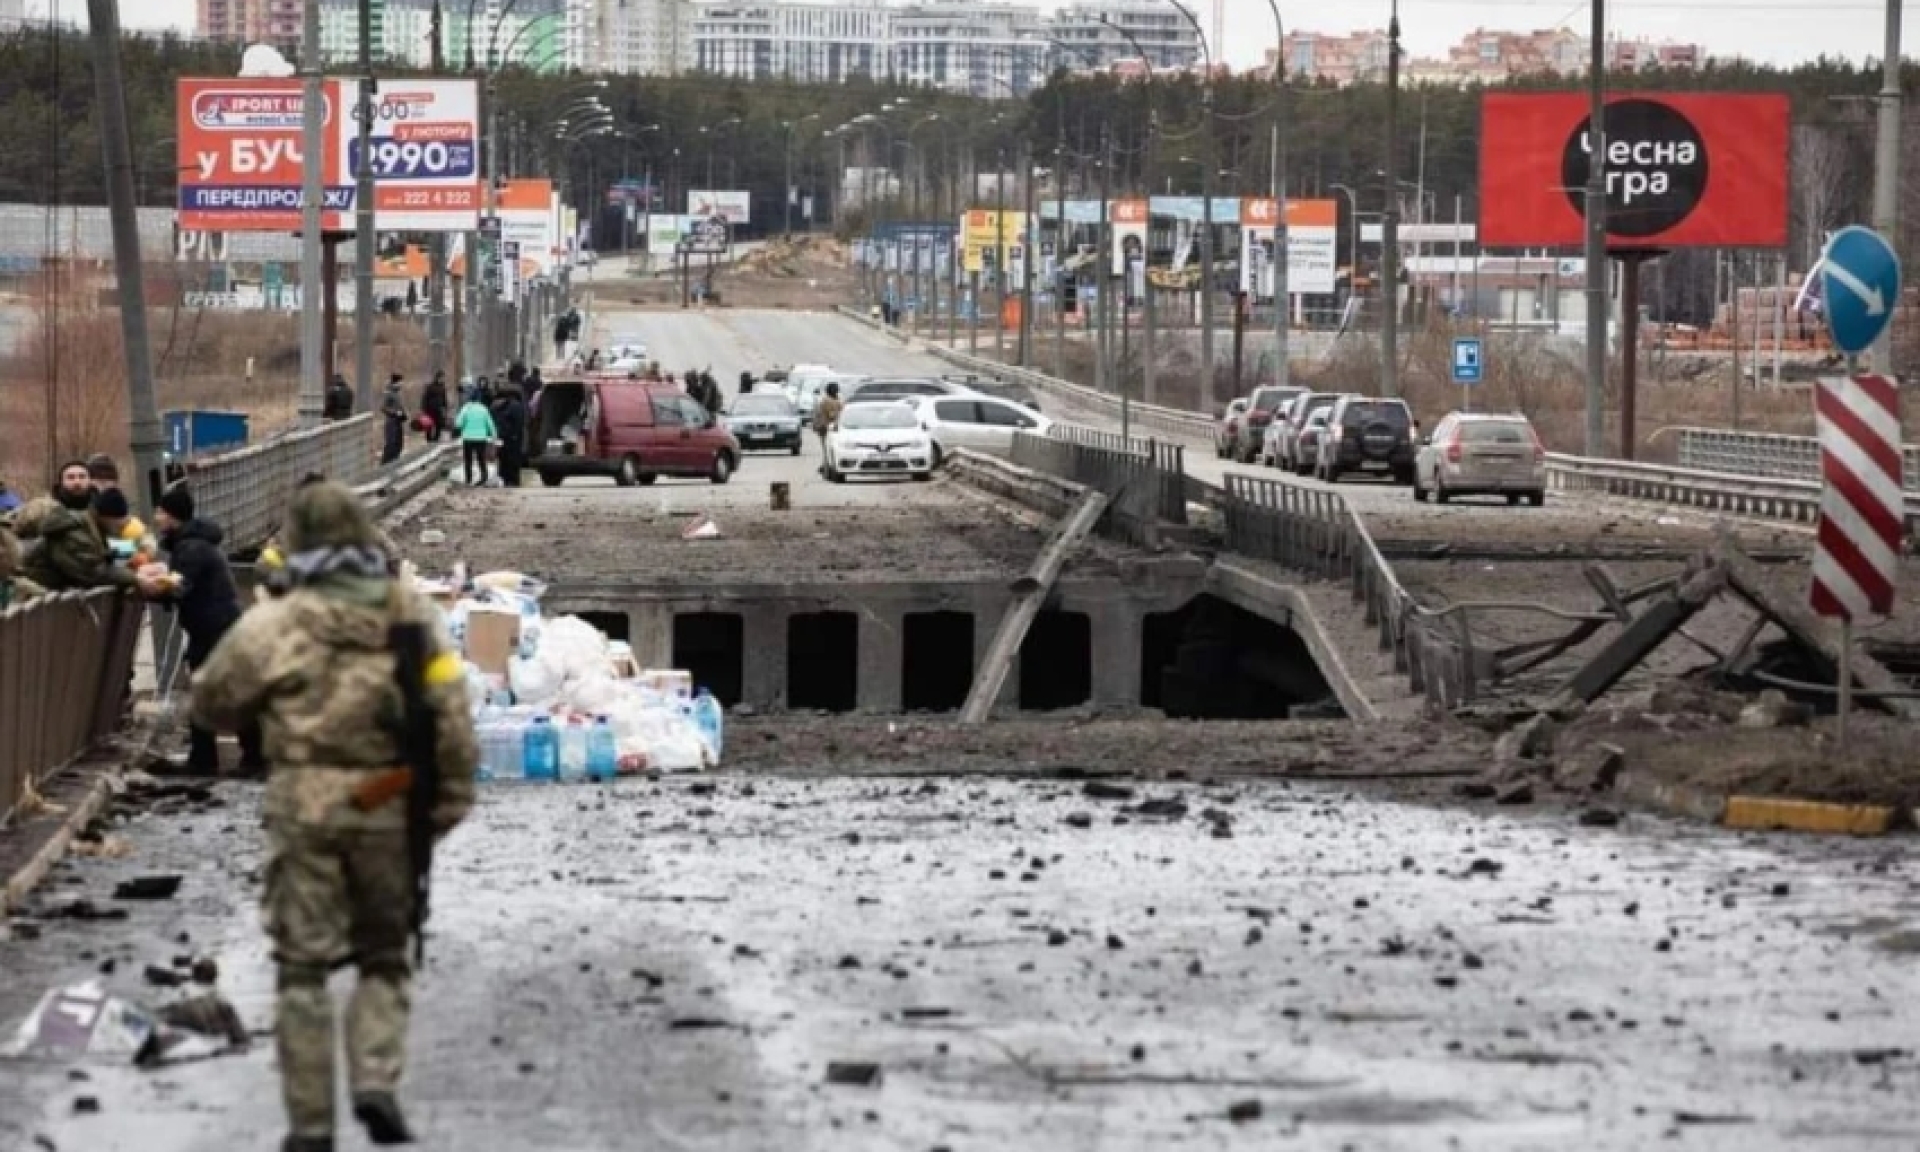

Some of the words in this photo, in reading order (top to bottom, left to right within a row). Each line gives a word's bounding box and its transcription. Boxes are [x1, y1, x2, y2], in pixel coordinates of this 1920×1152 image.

[196, 150, 220, 181] у
[231, 138, 304, 173] БУЧ
[1605, 171, 1670, 205] гра
